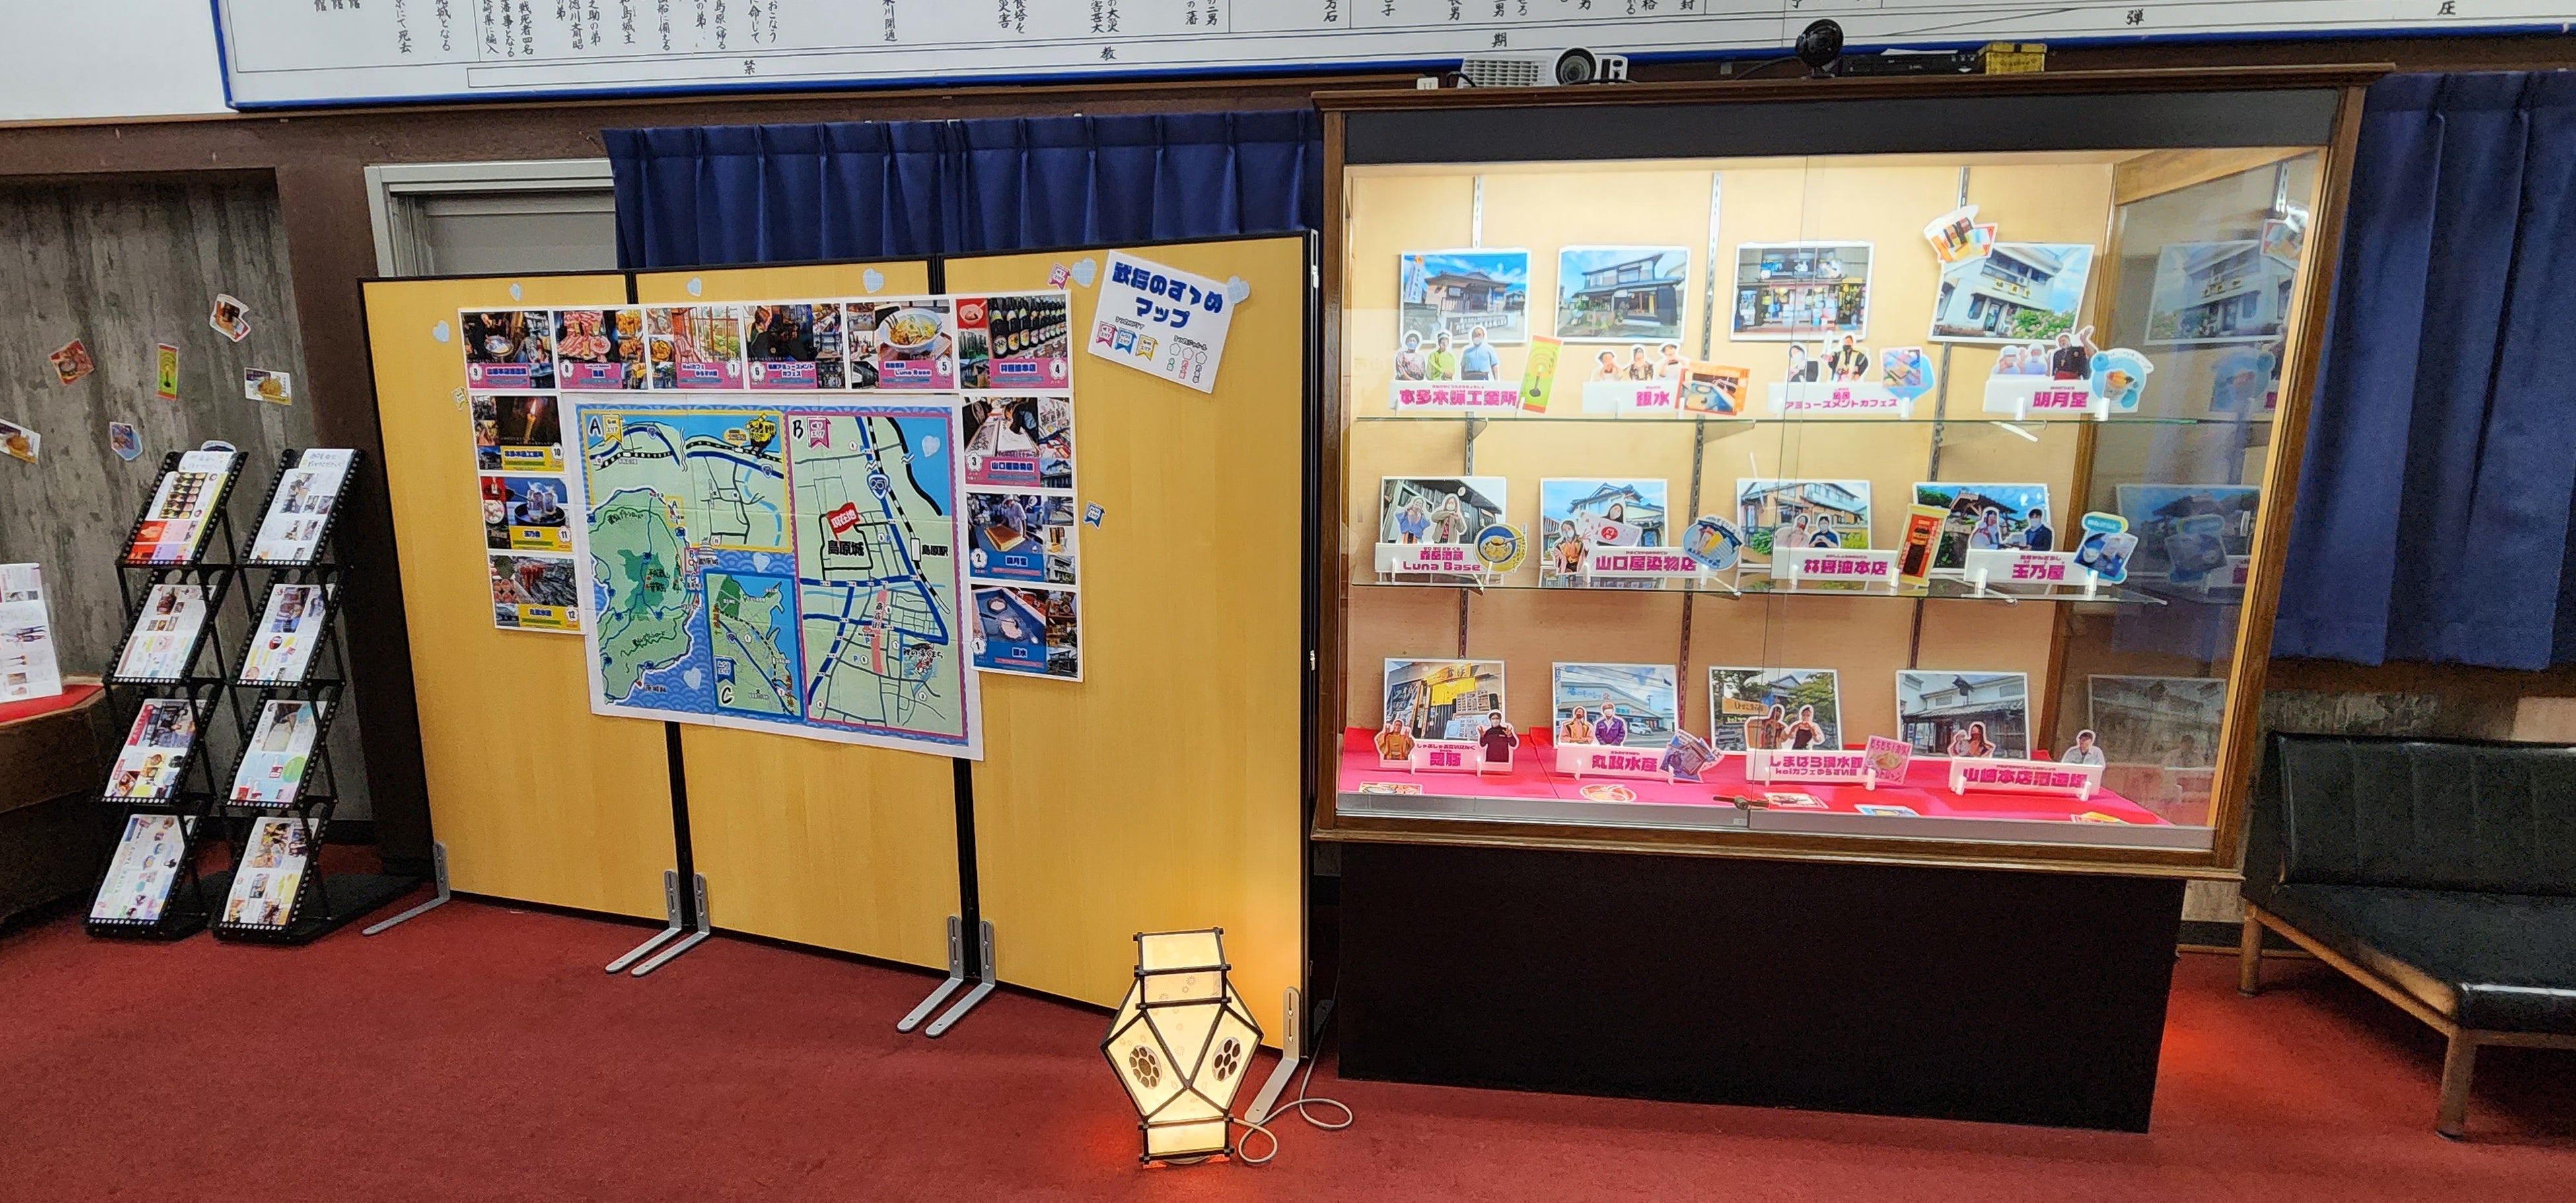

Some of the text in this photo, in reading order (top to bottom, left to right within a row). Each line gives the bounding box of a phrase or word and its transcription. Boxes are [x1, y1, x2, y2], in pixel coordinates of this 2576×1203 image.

[1381, 0, 1396, 17] 子
[693, 0, 707, 28] の弟
[744, 59, 755, 75] 禁
[1100, 46, 1117, 61] 教
[1491, 32, 1507, 48] 期
[2126, 10, 2145, 26] 弾
[1135, 296, 1190, 329] マップ
[564, 365, 569, 374] 8
[942, 361, 947, 371] 5
[1055, 364, 1060, 374] 4
[473, 367, 478, 377] 9
[755, 367, 760, 376] 6
[2032, 390, 2089, 408] 明月堂
[590, 418, 602, 435] A
[793, 419, 805, 439] B
[972, 456, 977, 466] 3
[870, 479, 887, 490] 251
[672, 500, 678, 509] A
[561, 531, 568, 540] 11
[976, 554, 982, 562] 2
[1403, 561, 1481, 571] Luna Base
[1595, 555, 1697, 572] 山口屋染物店
[568, 610, 575, 620] 12
[721, 687, 733, 704] C
[1591, 754, 1658, 772] 丸政水産
